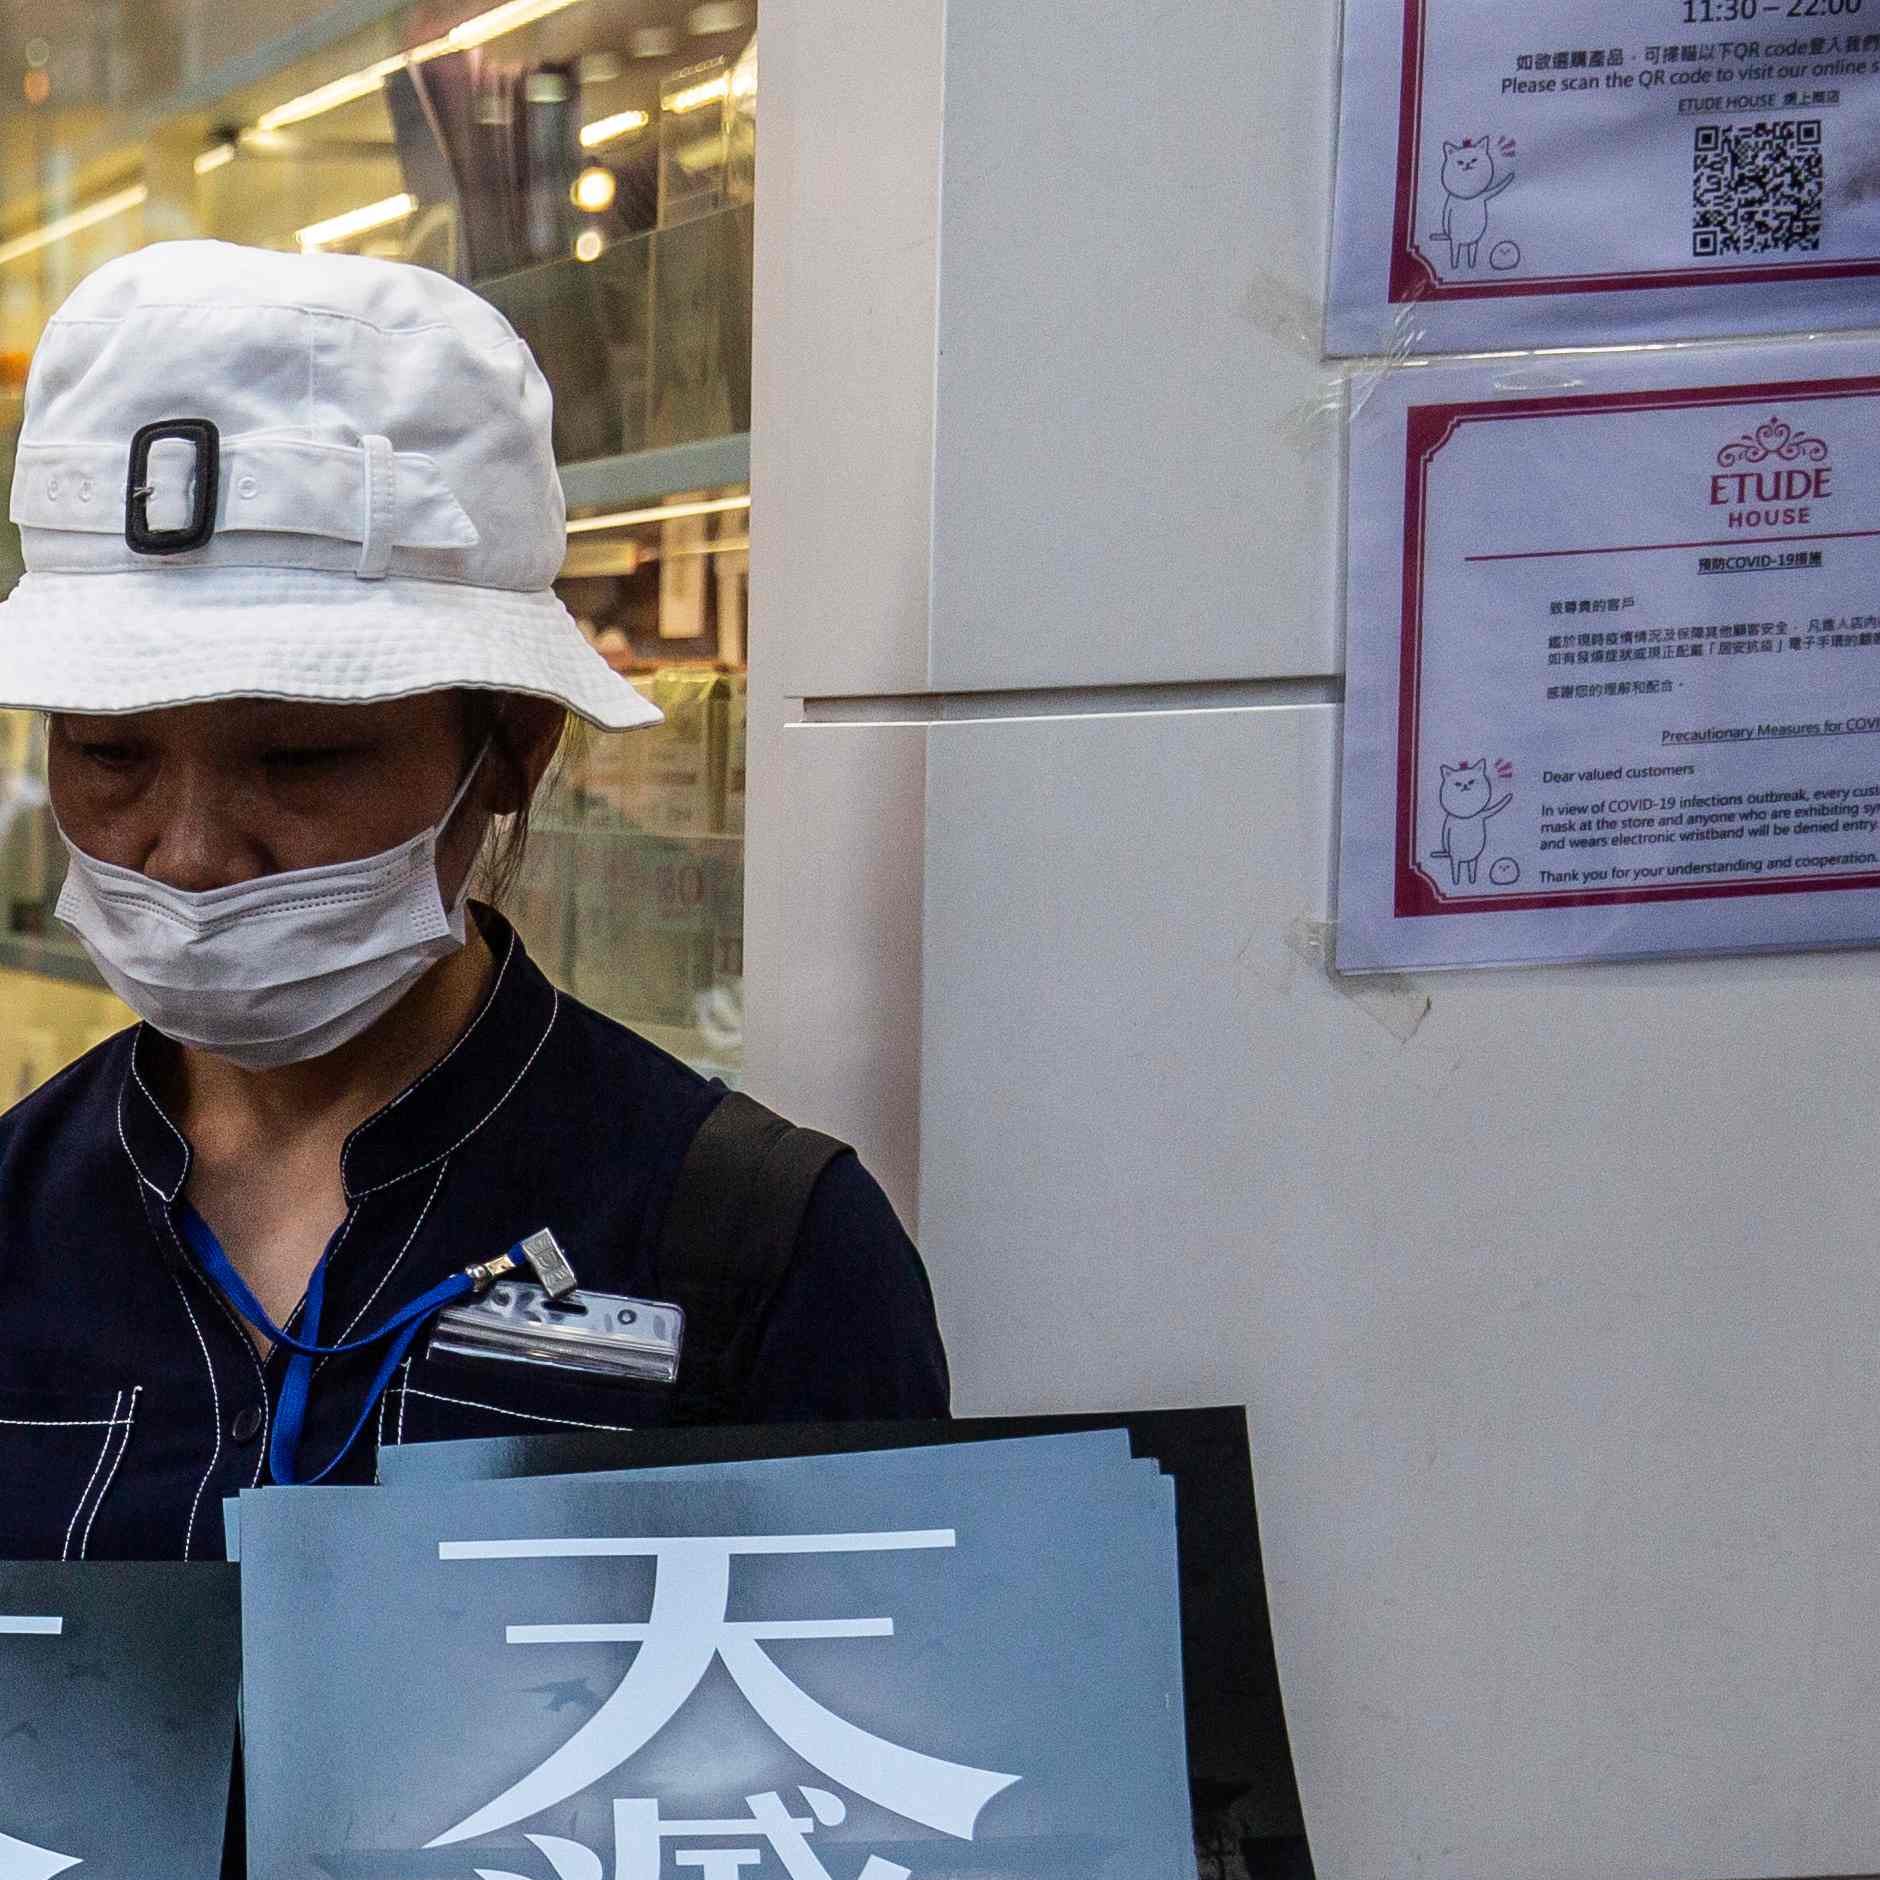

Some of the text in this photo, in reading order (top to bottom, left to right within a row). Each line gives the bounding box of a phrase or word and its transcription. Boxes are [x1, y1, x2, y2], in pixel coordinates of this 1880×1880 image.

[1684, 0, 1756, 23] 11:30
[1502, 76, 1556, 94] Please
[1561, 76, 1599, 91] scan
[1606, 71, 1633, 88] the
[1638, 69, 1665, 89] QR
[1670, 67, 1711, 85] code
[1716, 67, 1734, 82] to
[1737, 63, 1774, 81] visit
[1777, 65, 1808, 79] our
[1811, 58, 1867, 76] online
[1678, 96, 1723, 112] ETUDE
[1726, 93, 1776, 109] HOUSE
[1709, 467, 1833, 505] ETUDE
[1728, 507, 1811, 528] HOUSE
[1661, 717, 1880, 742] Precautionary Measures for COVI
[1543, 765, 1695, 783] Dear valued customers
[1541, 805, 1554, 817] In
[1557, 802, 1589, 815] view
[1591, 801, 1606, 814] of
[1608, 797, 1676, 813] COVID-19
[1680, 794, 1743, 809] infections
[1746, 789, 1809, 805] outbreak,
[1813, 788, 1850, 801] every
[1541, 820, 1576, 833] mask
[1579, 820, 1592, 831] at
[1596, 817, 1617, 831] the
[1621, 816, 1655, 829] store
[1658, 813, 1683, 826] and
[1686, 812, 1735, 827] anyone
[1738, 808, 1767, 821] who
[1770, 807, 1791, 820] are
[1794, 803, 1859, 818] exhibiting
[1540, 818, 1877, 850] and wears electronic wristband will be denied entry
[1540, 869, 1579, 883] Thank
[1582, 870, 1608, 884] you
[1611, 866, 1630, 879] for
[1633, 867, 1663, 880] your
[1666, 858, 1763, 876] understanding
[1767, 856, 1792, 869] and
